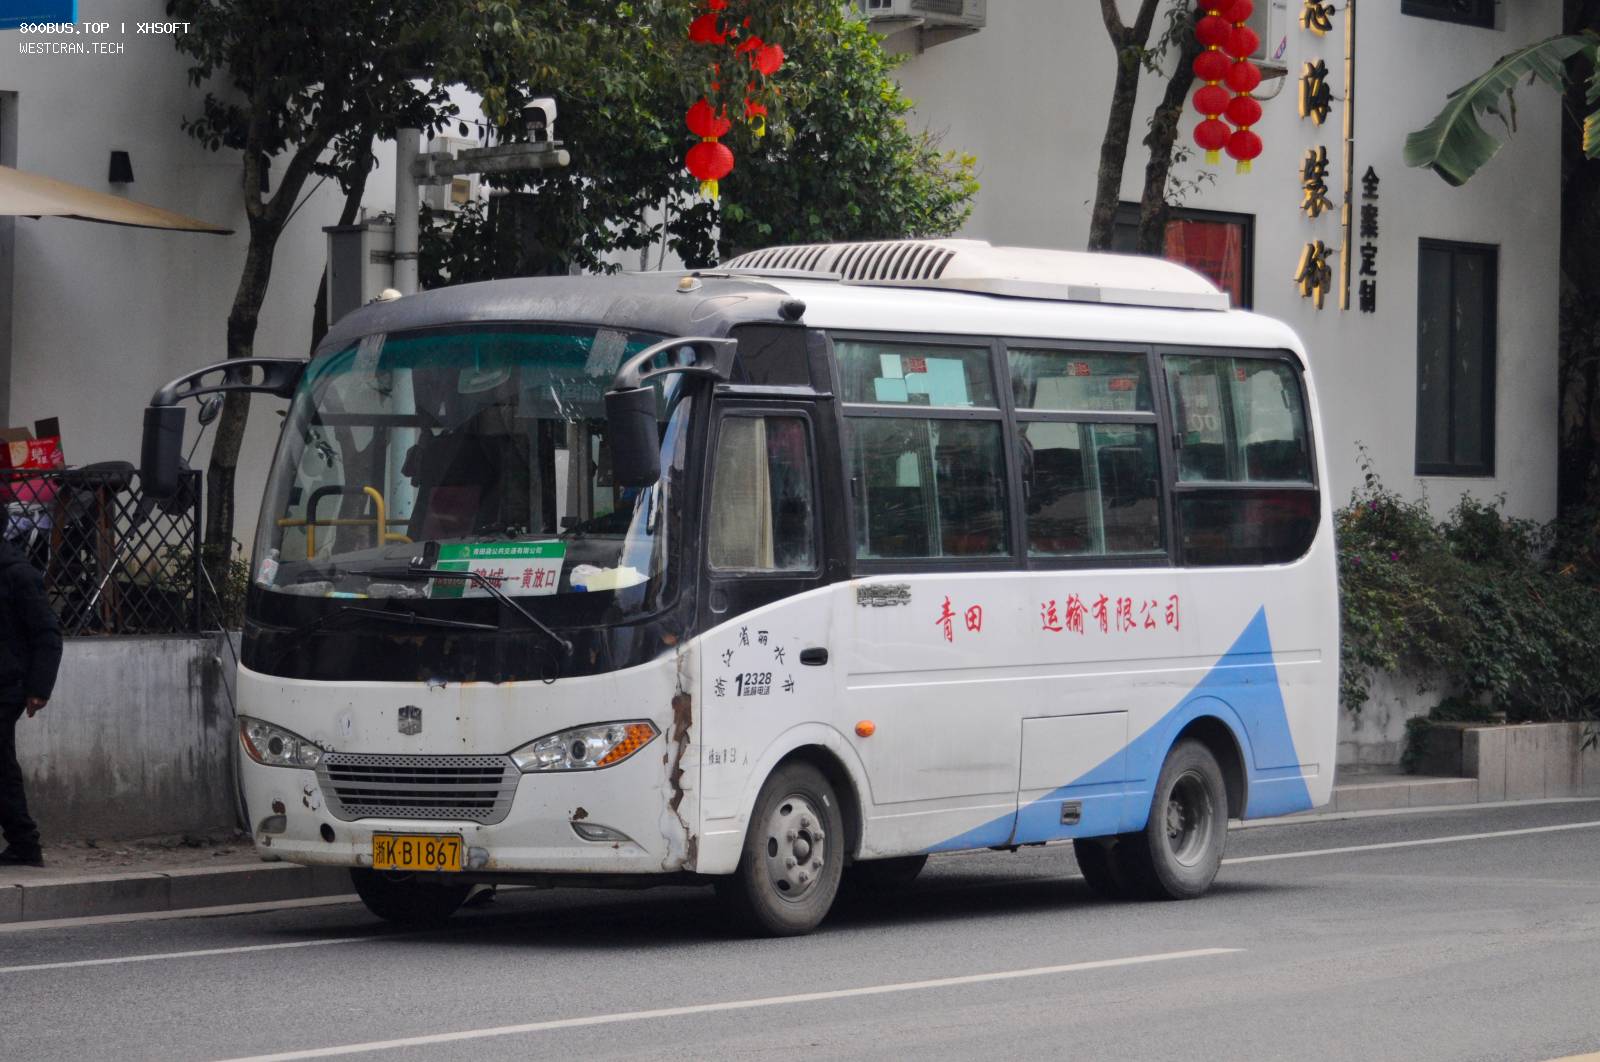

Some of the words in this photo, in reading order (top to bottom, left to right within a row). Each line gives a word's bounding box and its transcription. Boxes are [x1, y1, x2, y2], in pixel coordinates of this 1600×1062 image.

[934, 595, 983, 643] 青田
[1040, 593, 1181, 634] 运输有限公司
[735, 671, 772, 697] 12328
